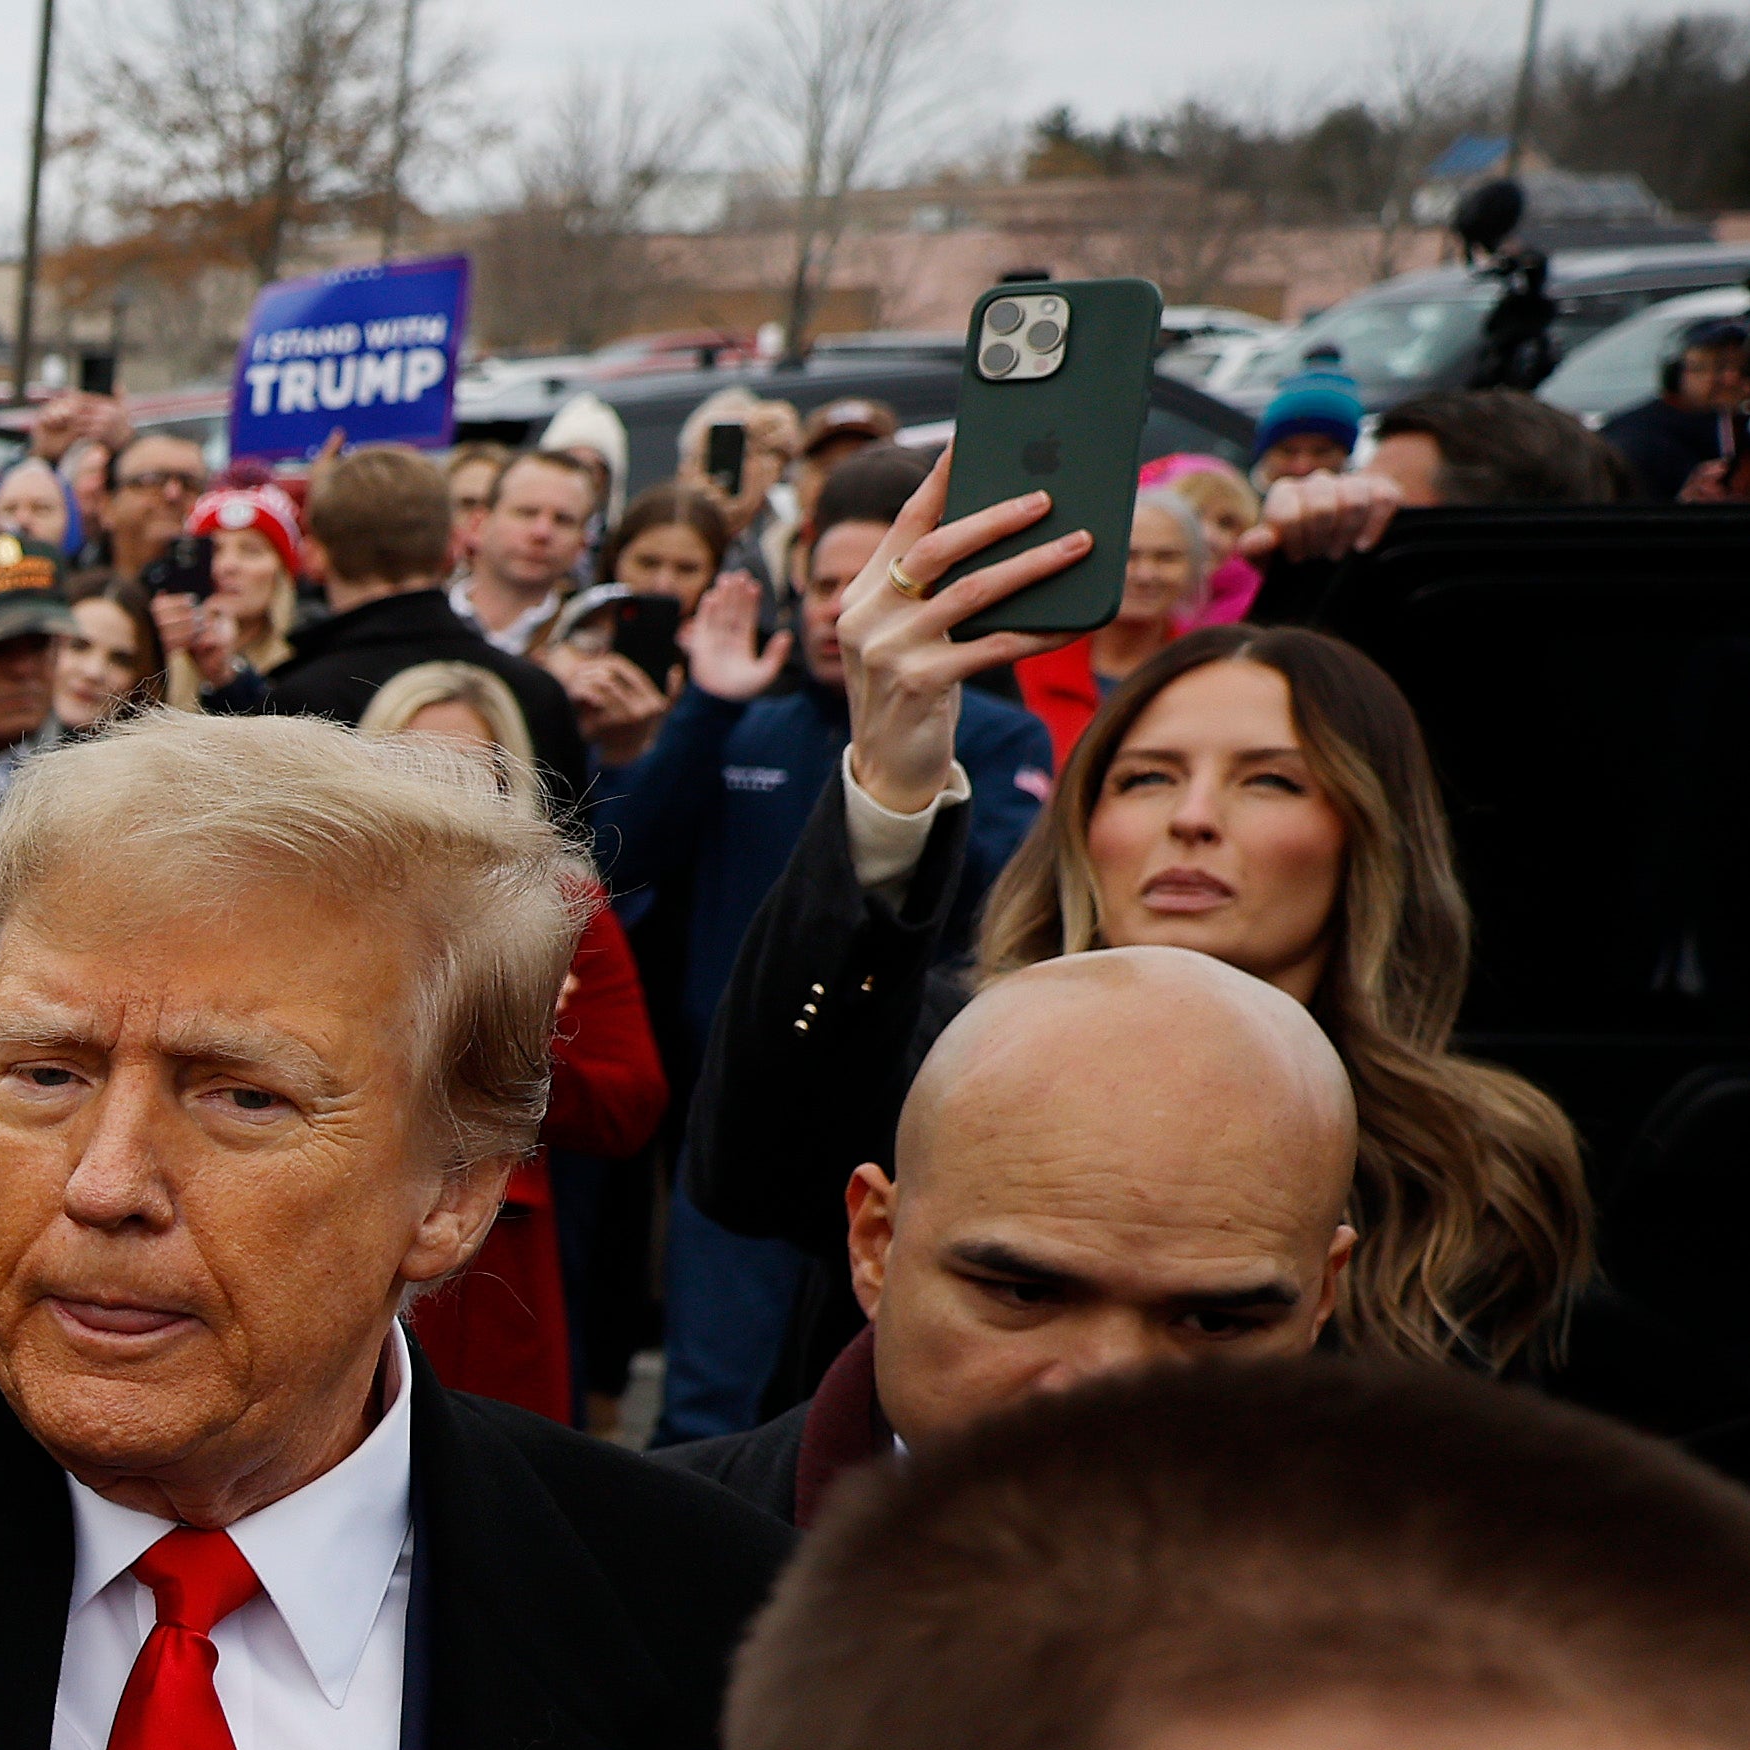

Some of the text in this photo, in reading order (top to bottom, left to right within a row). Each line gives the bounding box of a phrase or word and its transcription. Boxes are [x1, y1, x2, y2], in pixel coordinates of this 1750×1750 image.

[252, 313, 448, 361] I STAND WITH
[245, 346, 448, 417] TRUMP
